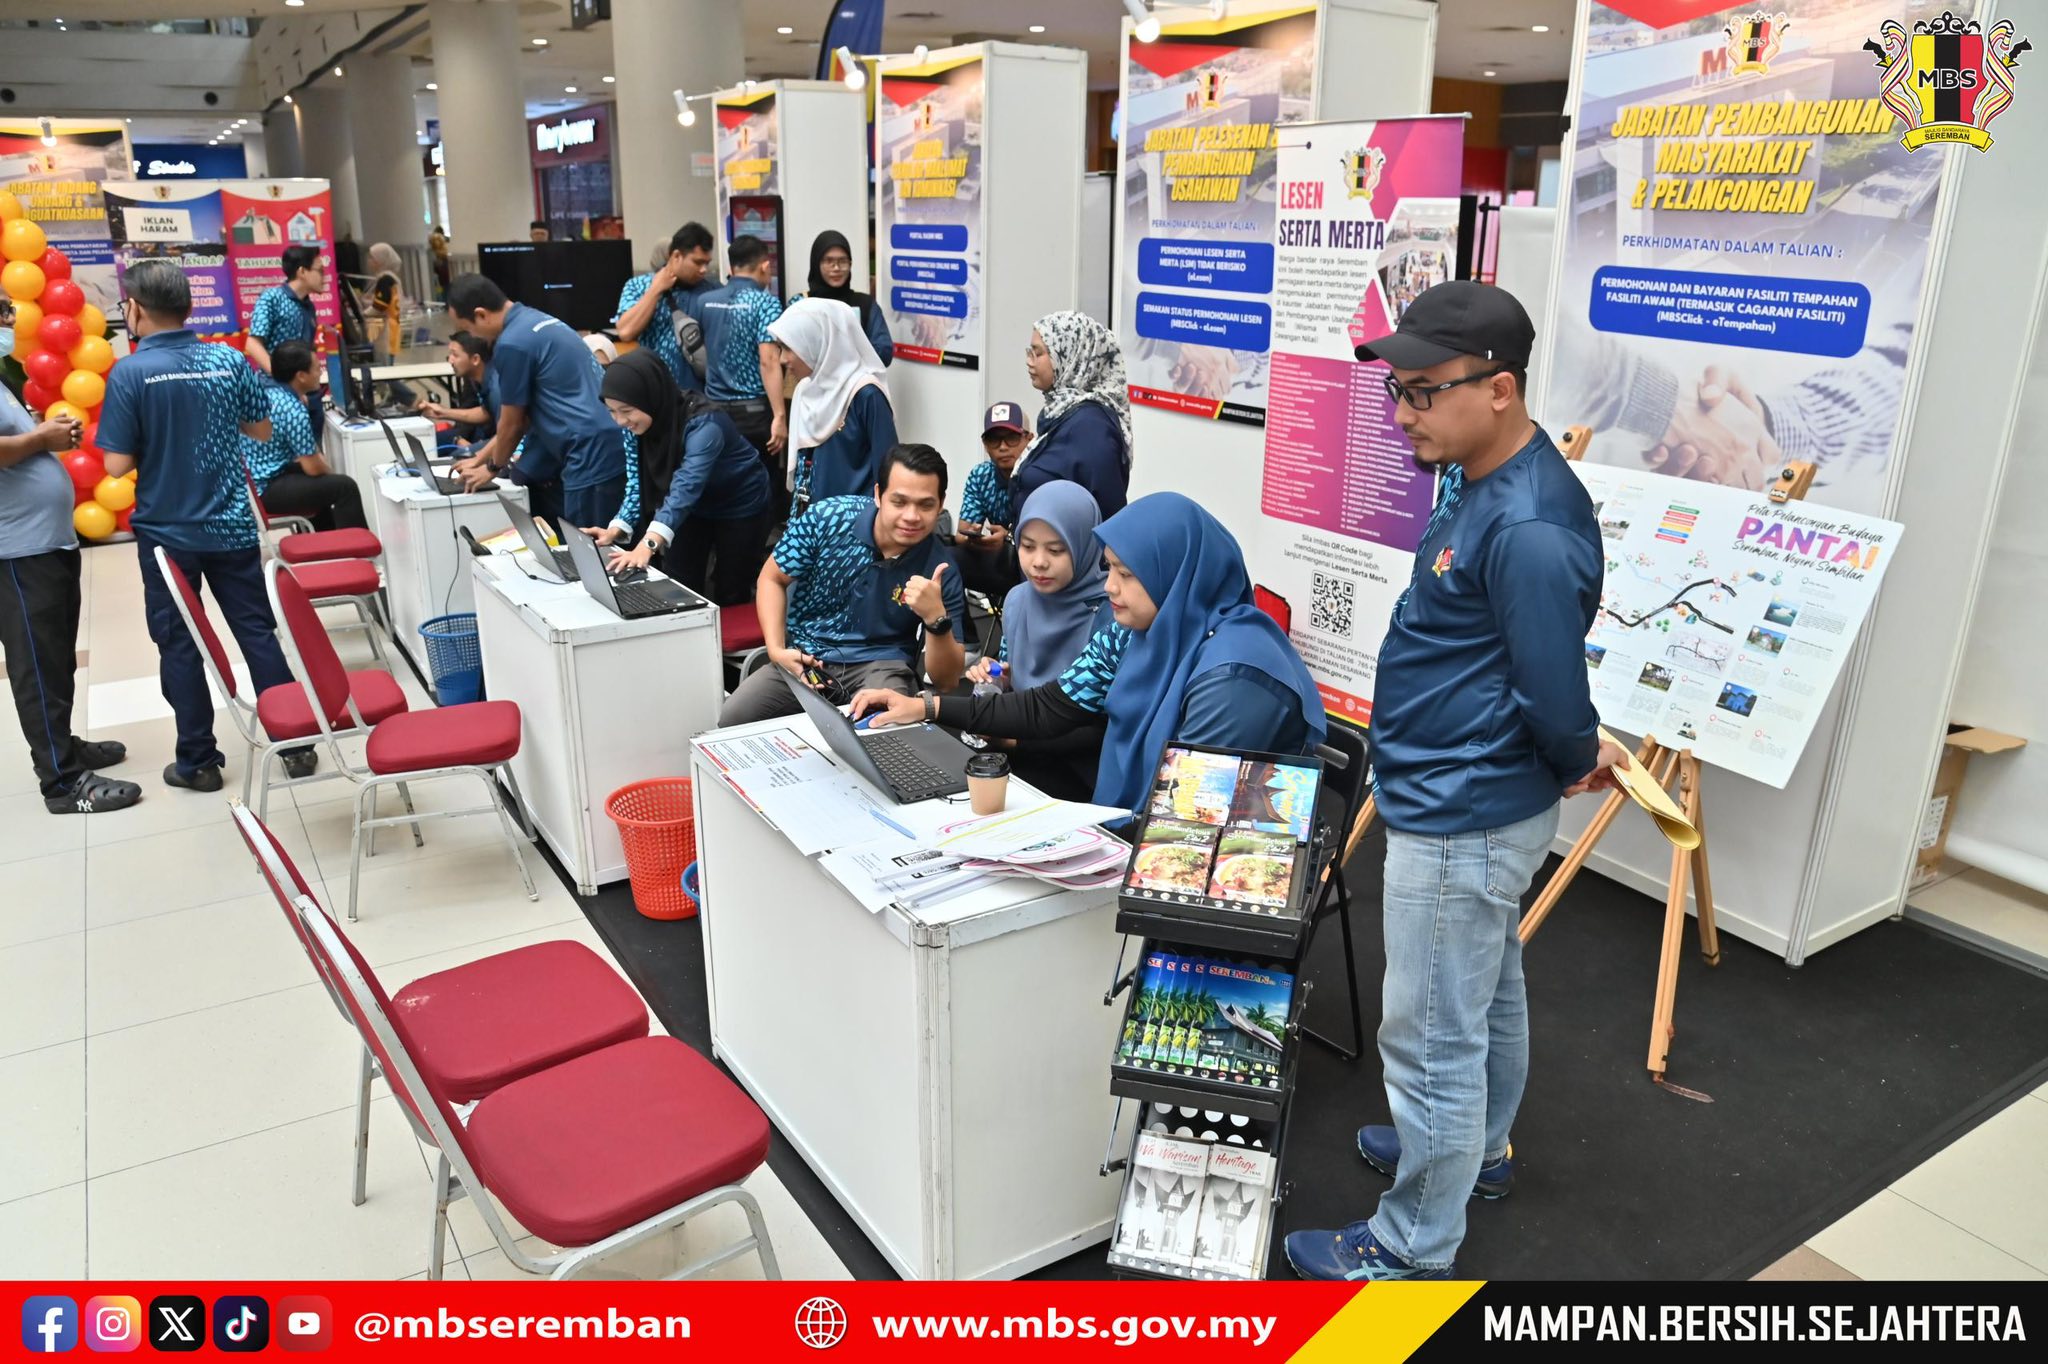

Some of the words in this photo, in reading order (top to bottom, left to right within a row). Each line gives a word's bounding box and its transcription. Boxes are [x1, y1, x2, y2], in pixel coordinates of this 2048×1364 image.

[1611, 104, 1706, 137] JABATAN
[1707, 98, 1897, 135] PEMBANGUNAN
[1143, 127, 1196, 151] JABATAN
[1199, 123, 1271, 149] PELESENAN
[1161, 151, 1256, 176] PEMBANGUNAN
[1655, 140, 1812, 174] MASYARAKAT
[1171, 177, 1242, 202] USAHAWAN
[1280, 182, 1324, 209] LESEN
[1631, 178, 1648, 210] &
[1651, 178, 1816, 213] PELANCONGAN
[1279, 219, 1322, 247] SERTA
[1328, 220, 1384, 250] MERTA
[1622, 235, 1720, 251] PERKHIDMATAN
[1724, 240, 1774, 255] DALAM
[1779, 243, 1833, 258] TALIAN
[1160, 246, 1202, 257] PERMOHONAN
[1204, 248, 1223, 258] LESEN
[1225, 249, 1246, 259] SERTA
[1197, 260, 1215, 270] TIDAK
[1216, 262, 1246, 272] BERISIKO
[1600, 277, 1667, 293] PERMOHONAN
[1670, 281, 1692, 295] DAN
[1693, 284, 1744, 299] BAYARAN
[1746, 288, 1789, 303] FASILITI
[1792, 292, 1858, 307] TEMPAHAN
[1143, 304, 1170, 315] SEMAKAN
[1171, 305, 1192, 317] STATUS
[1193, 309, 1239, 322] PERMOHONAN
[1240, 314, 1262, 325] LESEN
[1606, 291, 1642, 304] FASILITI
[1643, 296, 1675, 308] AWAM
[1676, 297, 1734, 313] (TERMASUK
[1737, 303, 1793, 319] CAGARAN
[1795, 308, 1846, 325] FASILITI)
[1657, 310, 1703, 325] (MBSClick
[1713, 317, 1776, 334] eTempahan)
[1737, 516, 1880, 570] PANTAI
[1838, 524, 1885, 545] Budaya
[1341, 545, 1358, 554] Code
[1358, 549, 1373, 560] bagi
[1331, 562, 1350, 573] Lesen
[1351, 568, 1367, 578] Serta
[1369, 573, 1388, 584] Merta
[1209, 966, 1270, 985] SEREMBAN
[1216, 1153, 1257, 1172] Heritage
